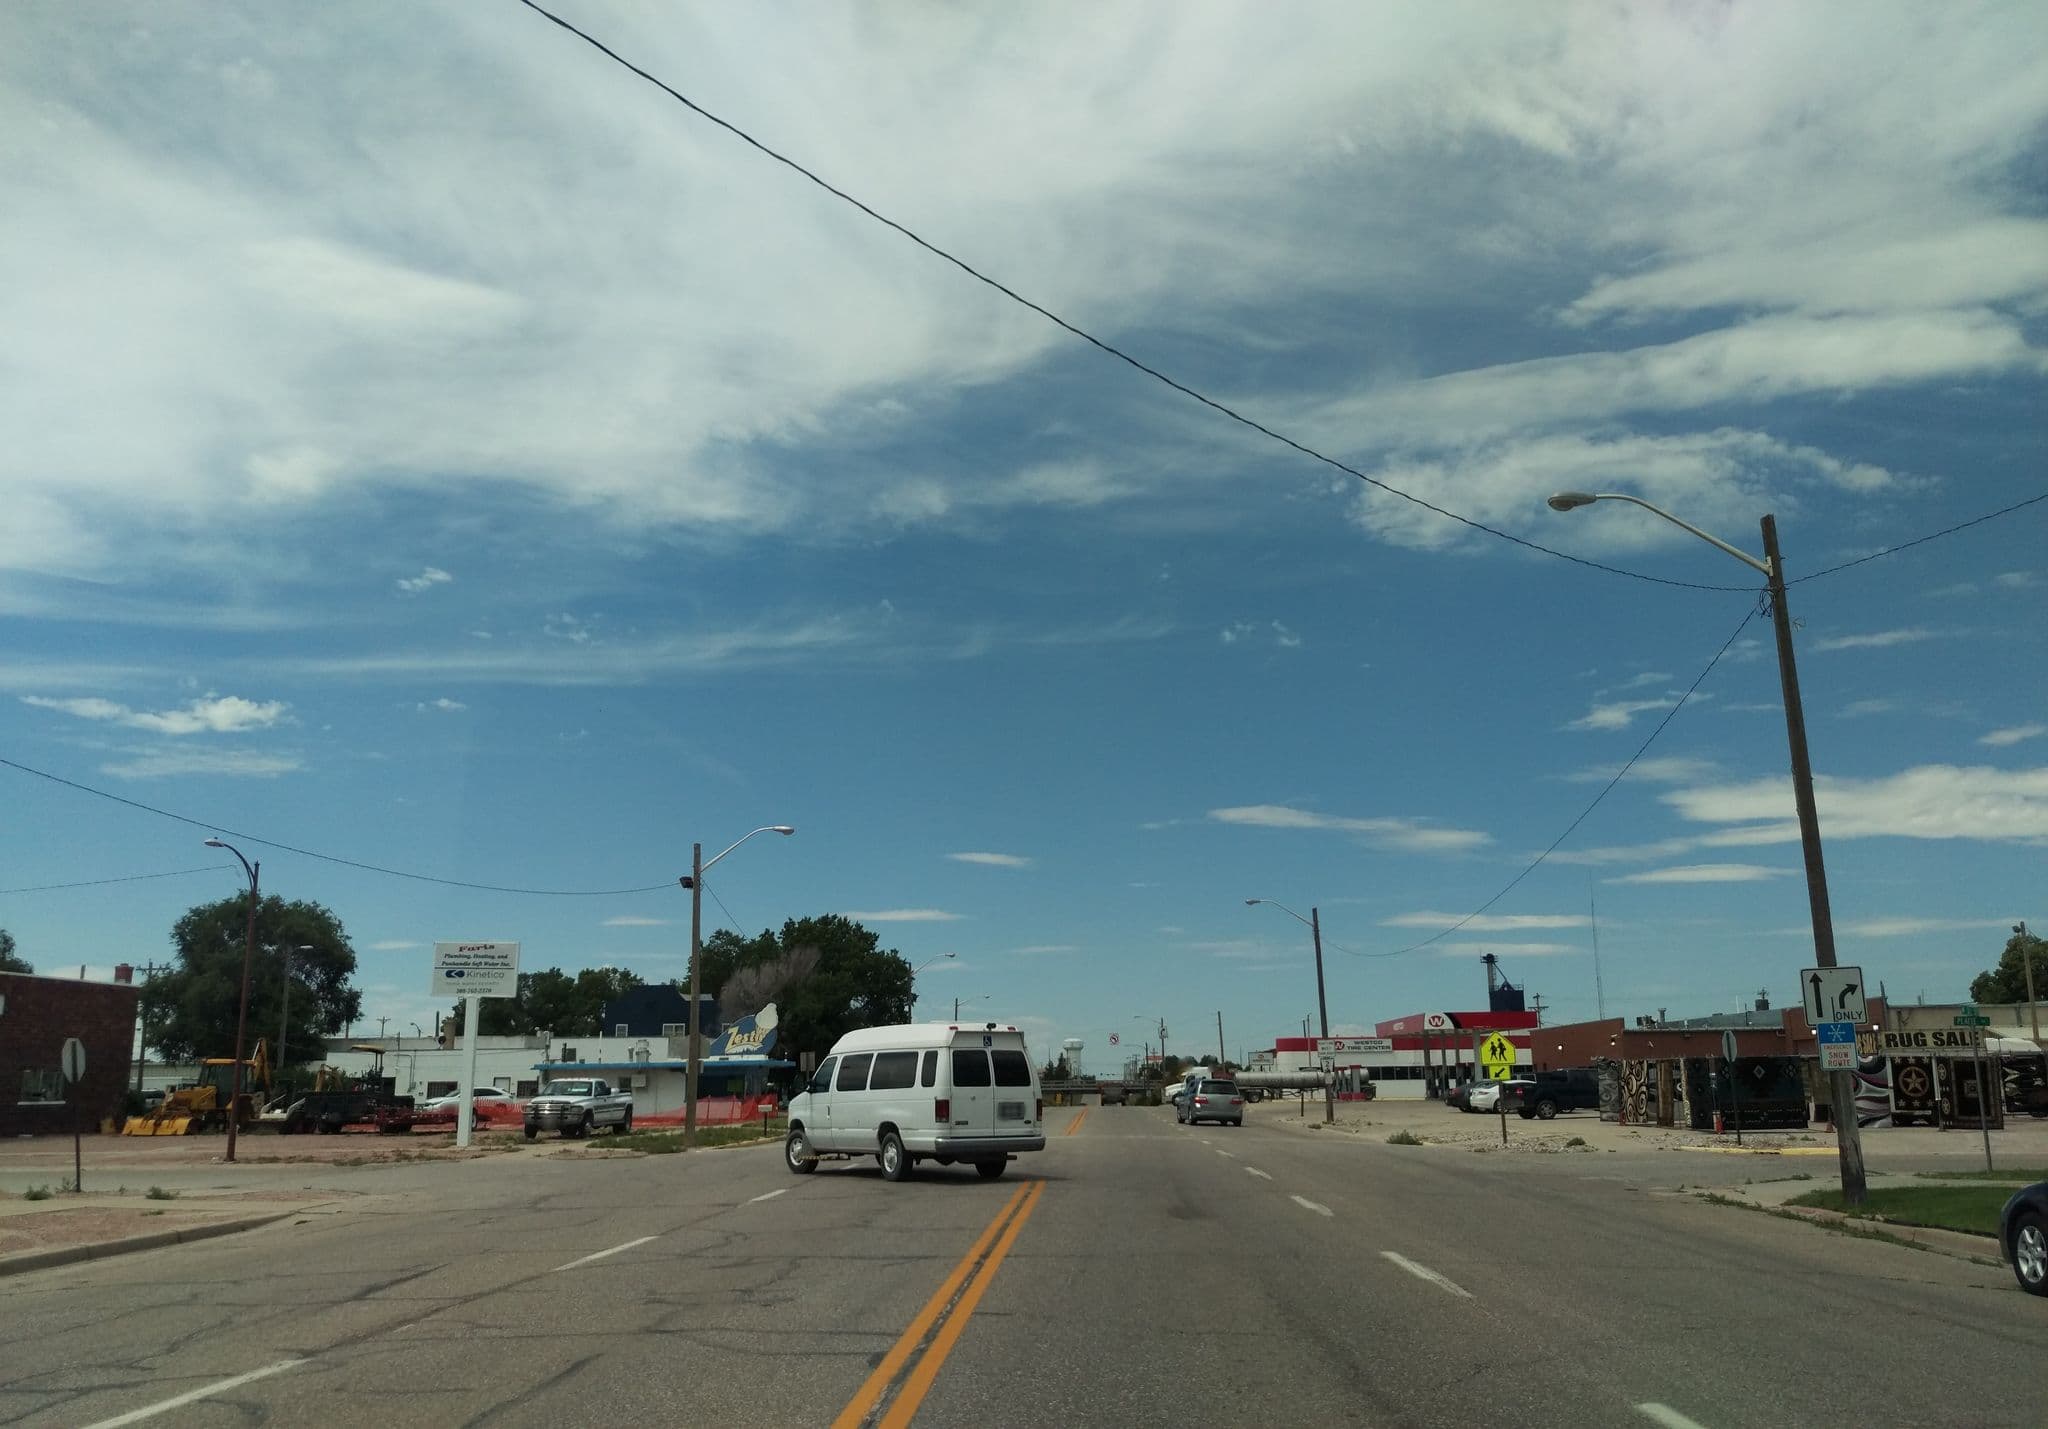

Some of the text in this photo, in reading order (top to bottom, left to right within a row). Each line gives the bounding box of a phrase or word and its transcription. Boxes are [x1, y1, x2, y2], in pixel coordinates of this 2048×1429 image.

[466, 970, 505, 979] Kinetico
[1836, 1011, 1862, 1020] ONLY
[1885, 1032, 1927, 1047] RUG
[1932, 1031, 1980, 1047] SALE
